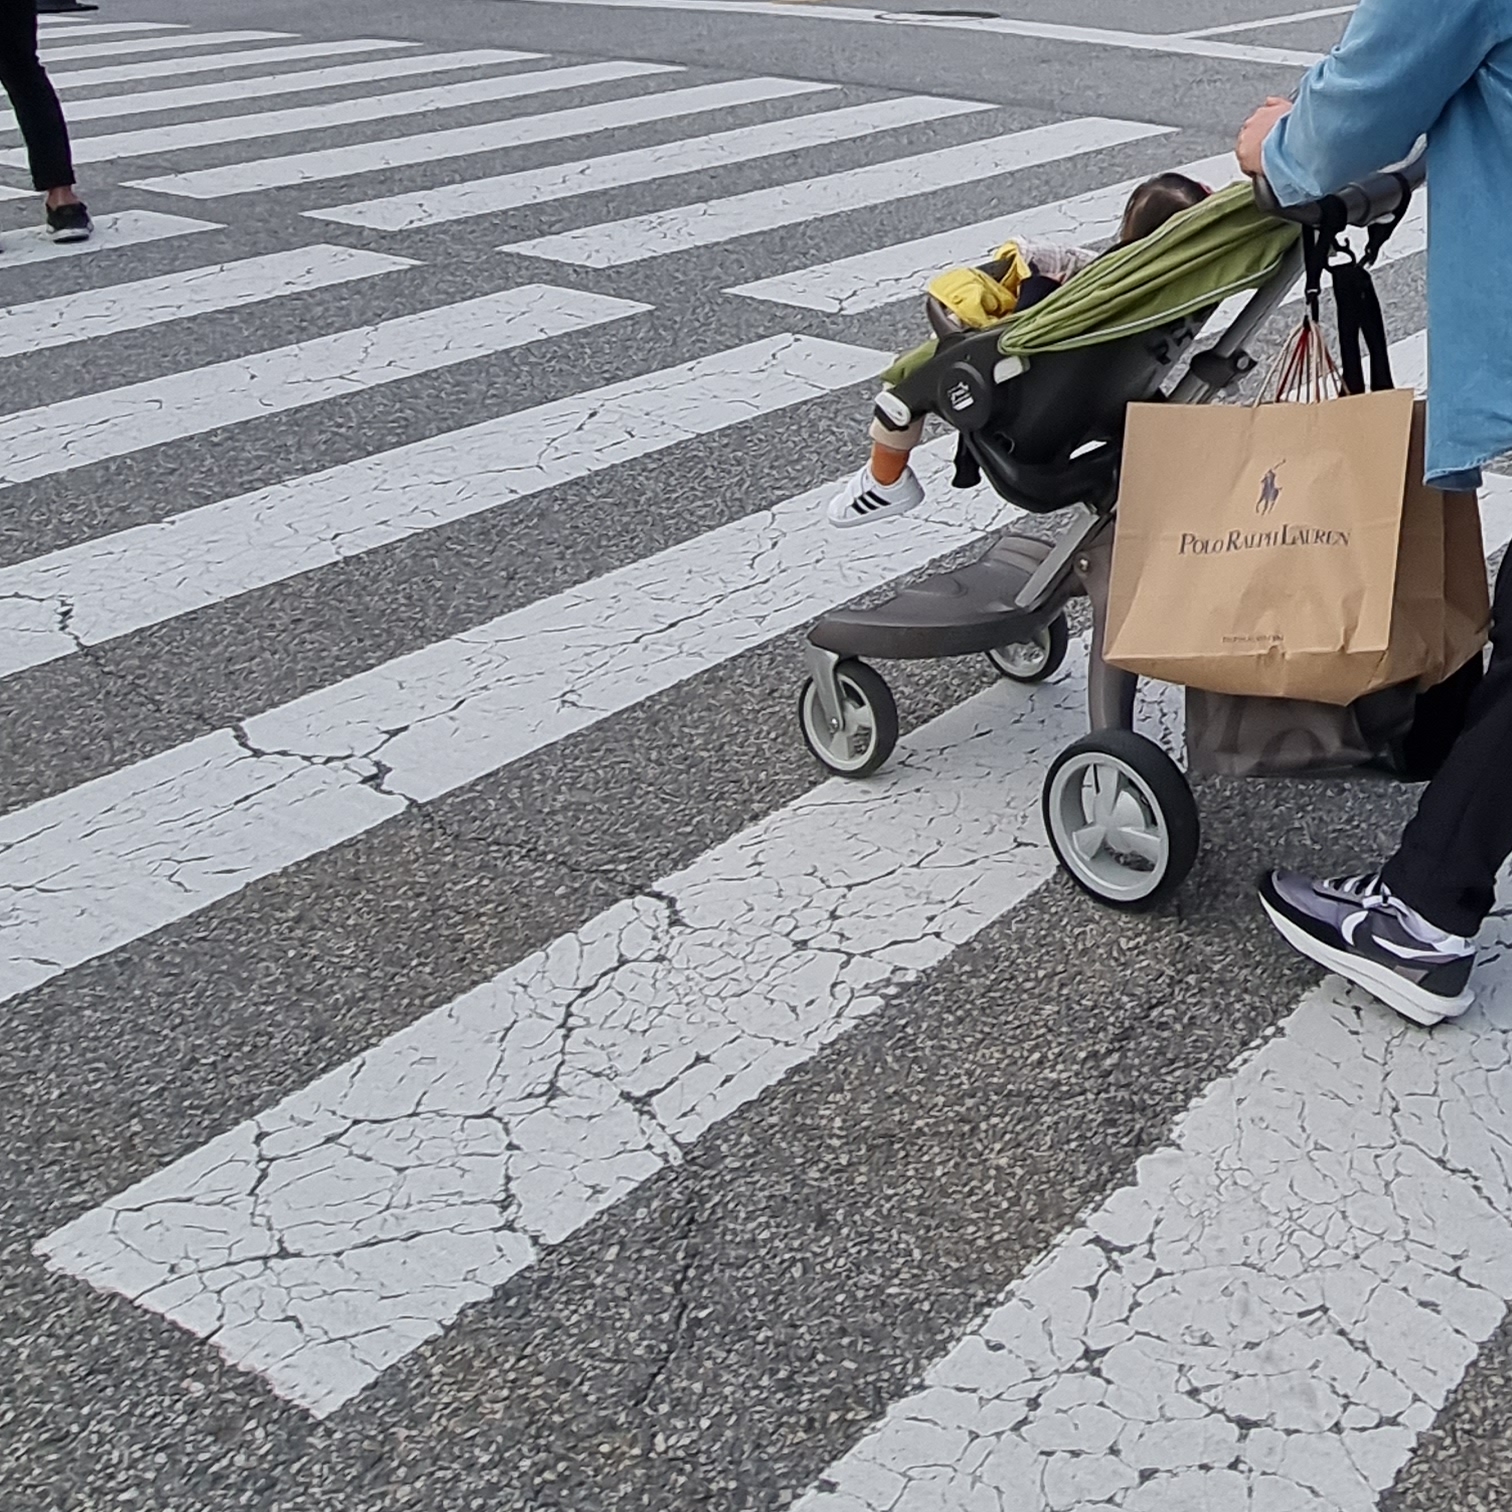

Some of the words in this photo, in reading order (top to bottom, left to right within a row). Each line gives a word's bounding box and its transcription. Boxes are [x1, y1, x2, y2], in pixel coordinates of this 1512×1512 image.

[1178, 532, 1225, 556] POLO
[1226, 528, 1280, 553] RALPH
[1281, 523, 1351, 547] LAUREN
